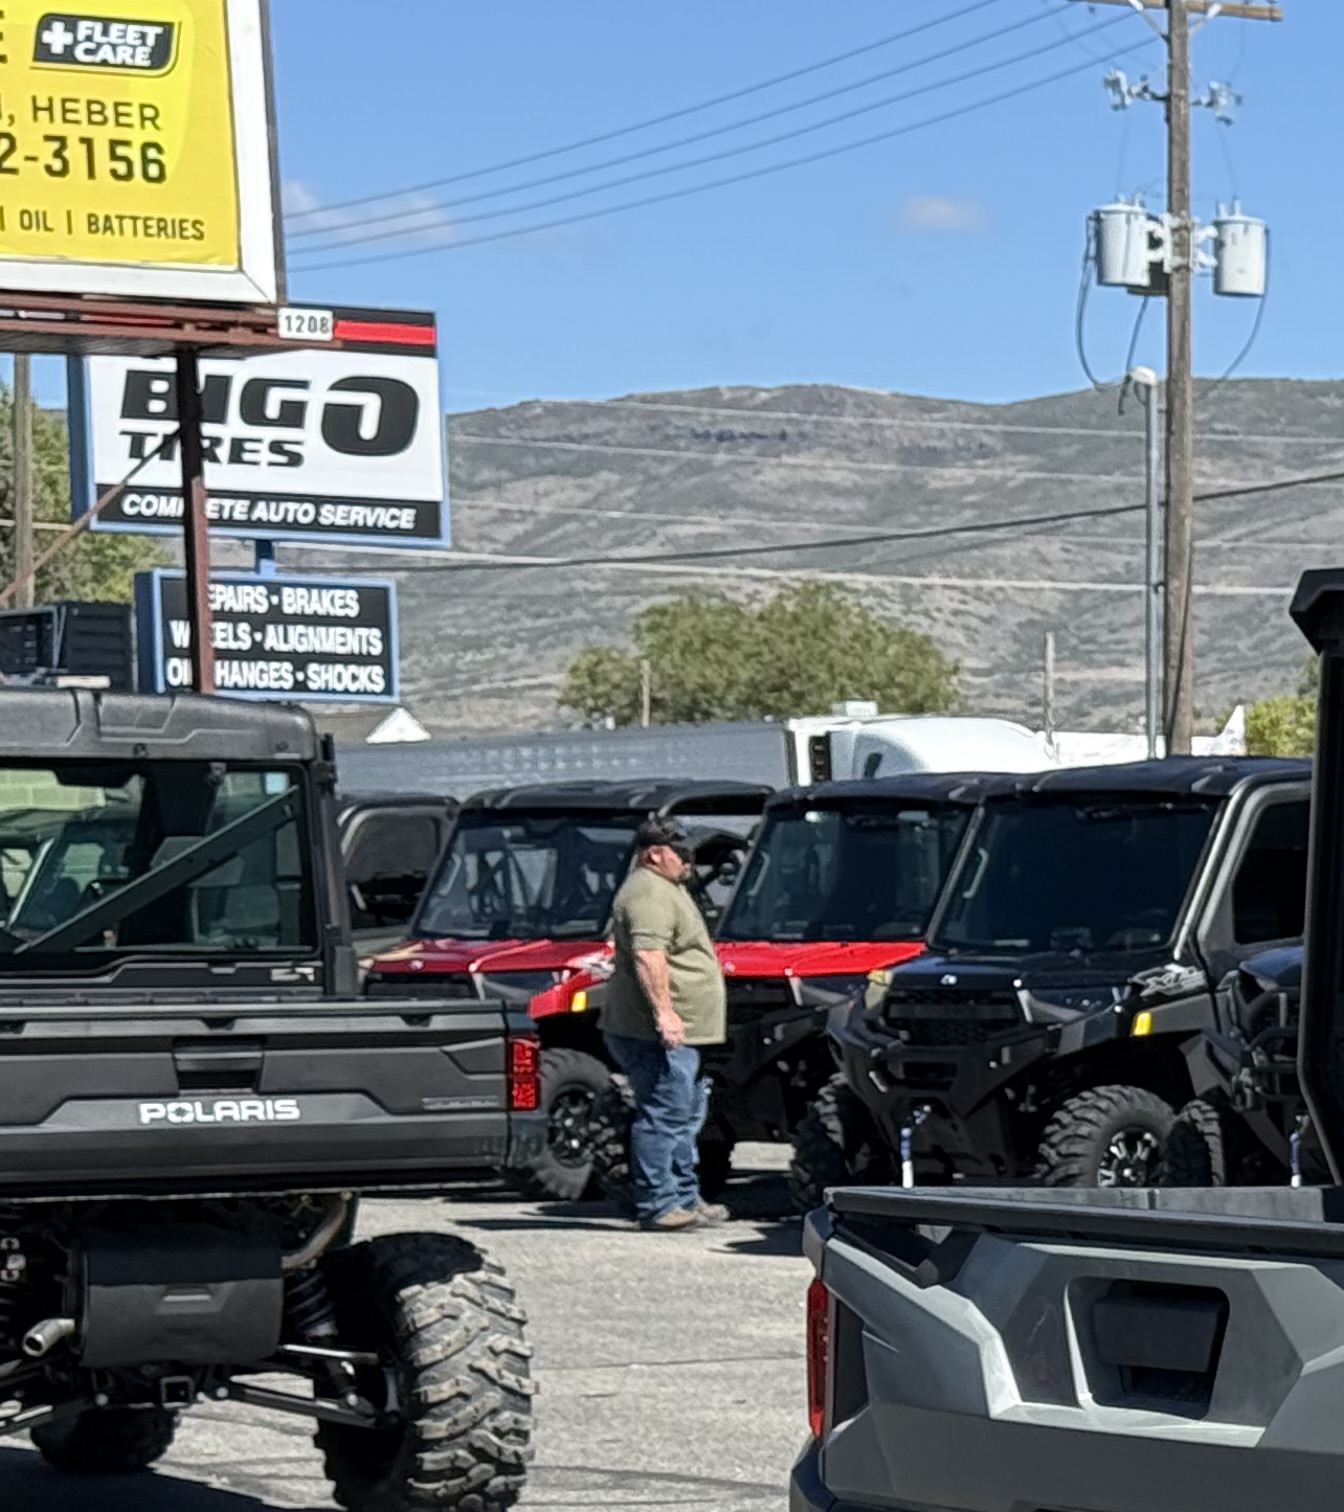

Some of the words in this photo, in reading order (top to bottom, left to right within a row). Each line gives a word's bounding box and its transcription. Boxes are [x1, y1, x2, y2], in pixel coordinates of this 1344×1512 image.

[77, 20, 164, 48] FLEET
[74, 42, 152, 68] CARE
[31, 95, 163, 131] HEBER
[19, 208, 55, 233] OIL
[87, 212, 206, 242] BATTERIES
[284, 314, 331, 335] 1208
[120, 369, 312, 429] BIG
[320, 375, 421, 458] O
[118, 431, 306, 468] TIRES
[121, 493, 251, 521] COMETE
[251, 501, 316, 525] AUTO
[317, 503, 418, 531] SERVICE
[281, 586, 360, 618] BRAKES
[263, 623, 383, 656] ALIGNMENTS
[214, 660, 294, 690] HANGES
[306, 662, 386, 694] SHOCKS
[139, 1098, 301, 1125] POLARIS
